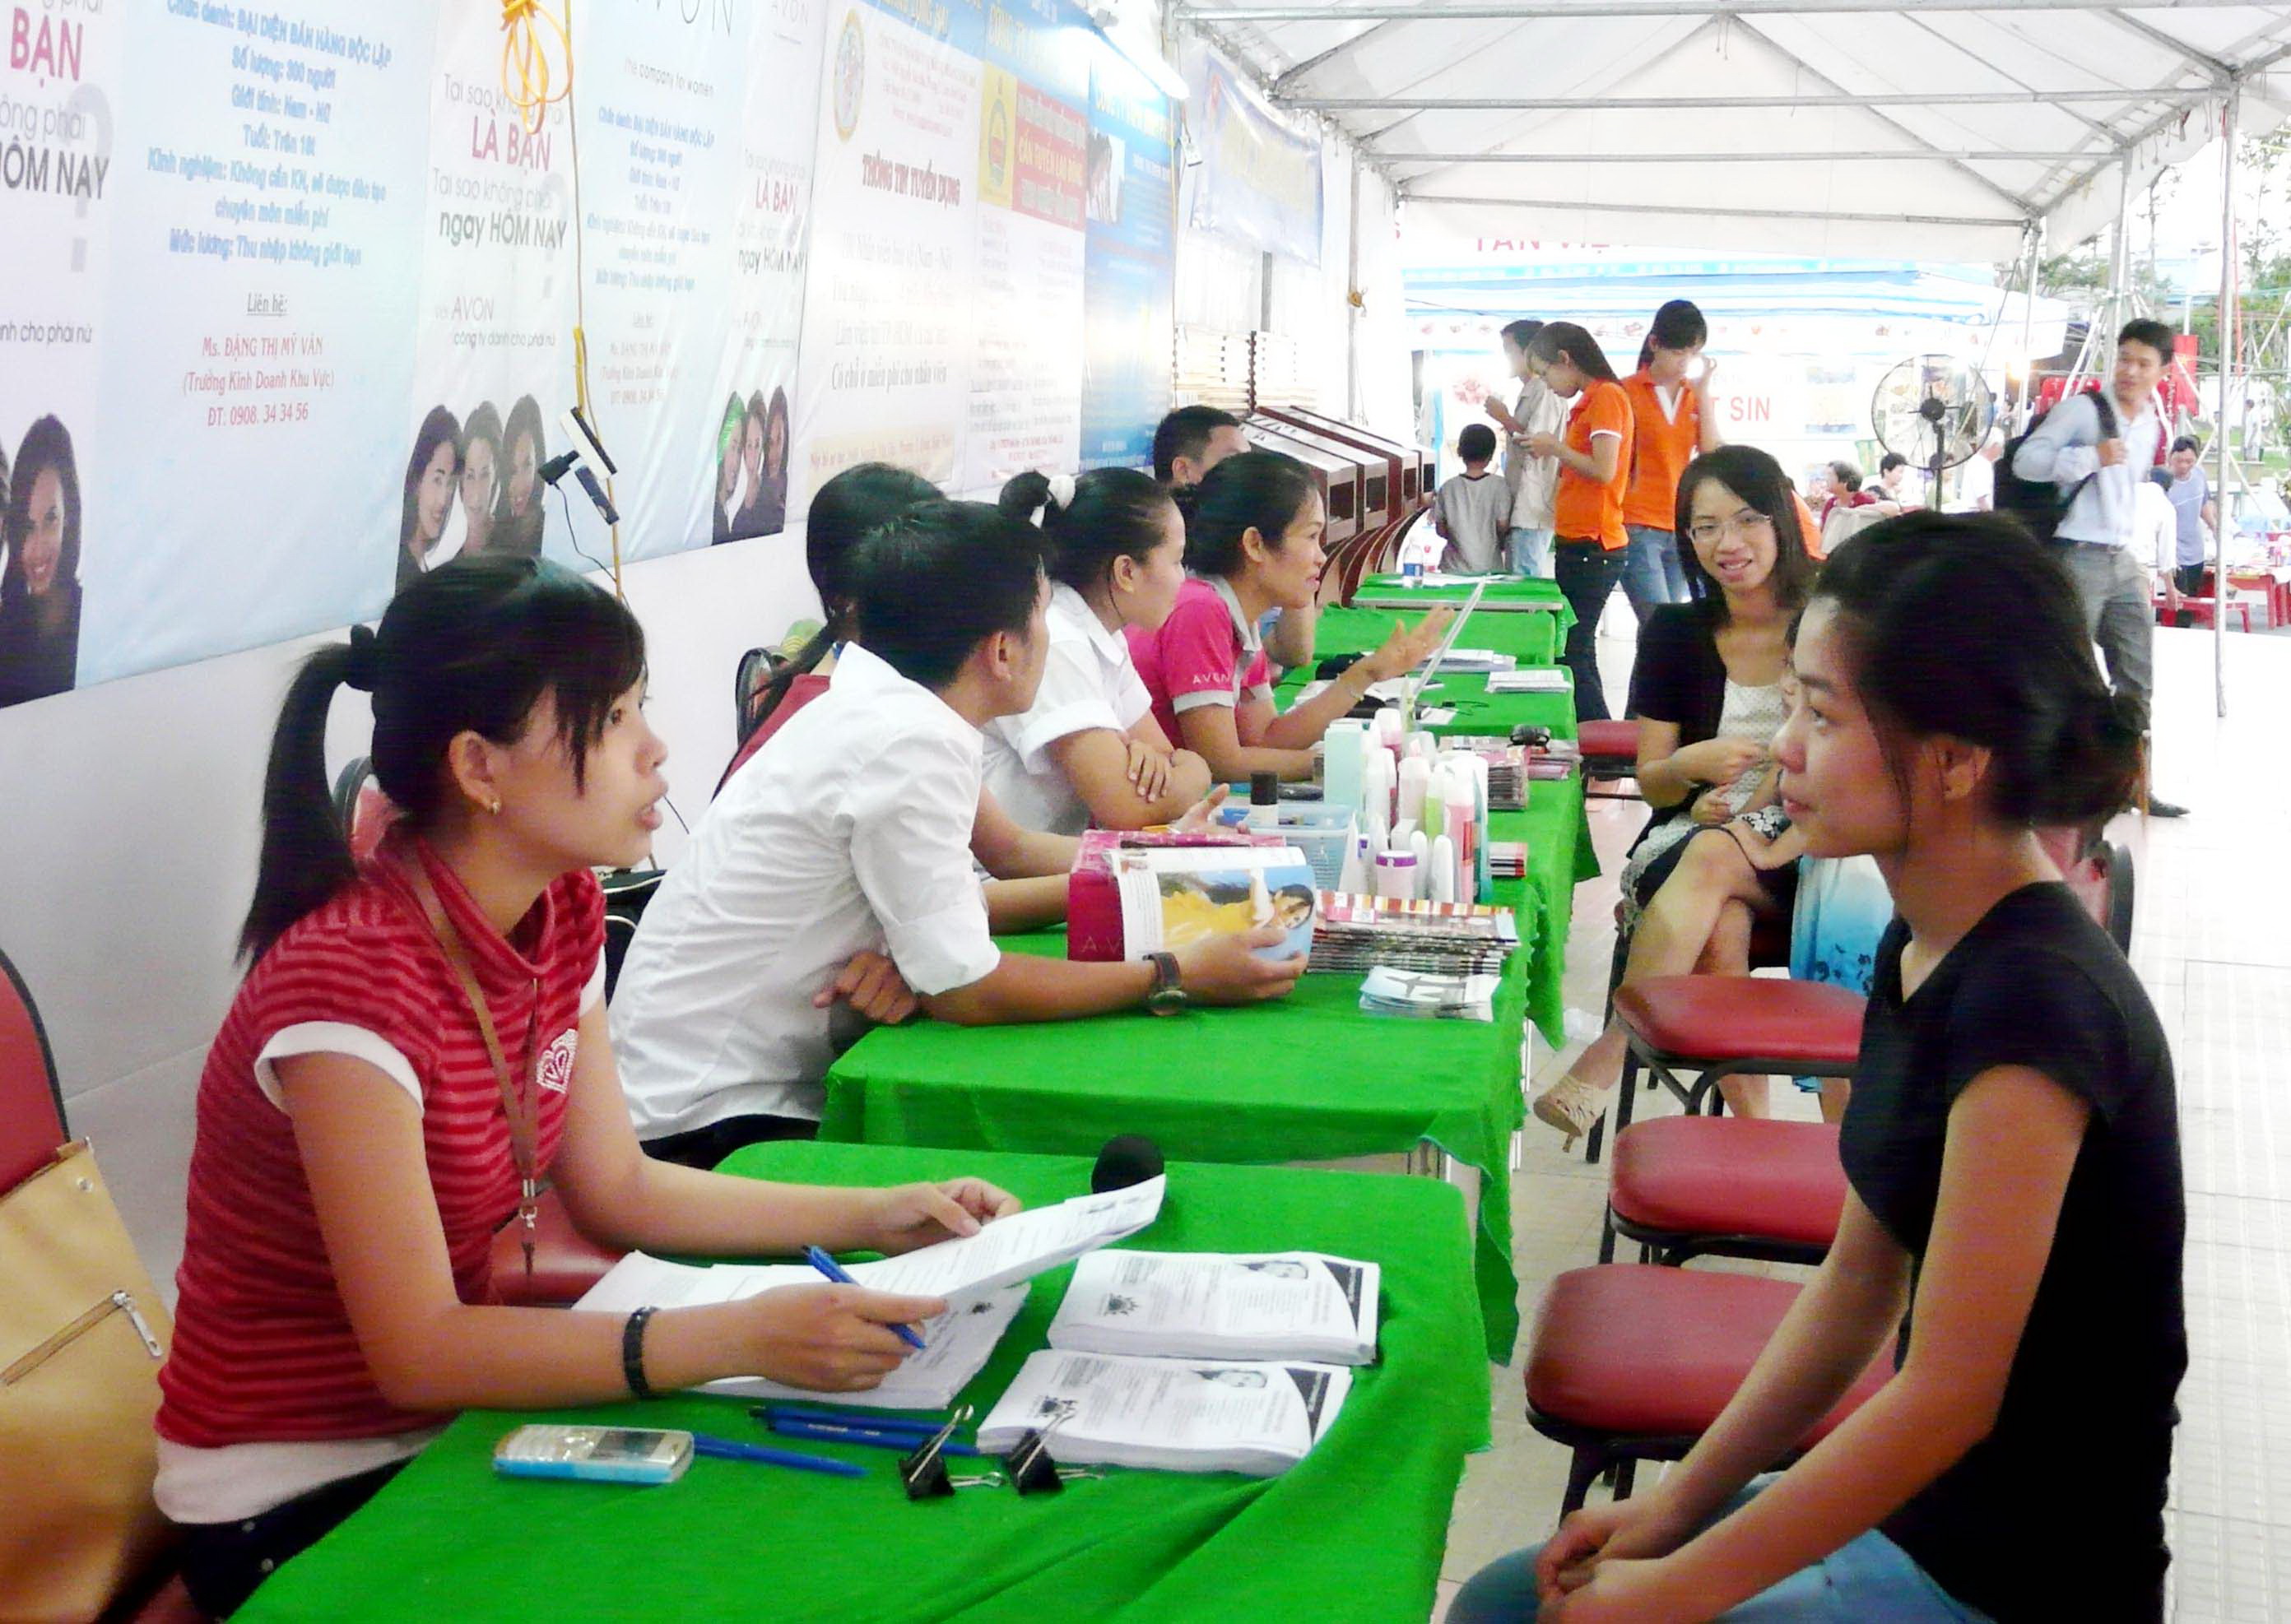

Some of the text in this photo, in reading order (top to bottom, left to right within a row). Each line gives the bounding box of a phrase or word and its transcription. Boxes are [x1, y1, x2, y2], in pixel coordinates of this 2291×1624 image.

[11, 7, 84, 89] BẠN
[472, 107, 552, 176] LÀ BẠN
[0, 134, 110, 201] ÔM NAY
[455, 177, 481, 202] sao
[438, 211, 486, 249] ngay
[489, 206, 531, 247] HÔM
[533, 217, 569, 250] NAY
[452, 296, 495, 322] AVON
[20, 318, 47, 343] cho
[289, 369, 310, 389] Khu
[263, 402, 277, 424] 34
[279, 401, 293, 422] 34
[295, 401, 310, 421] 56
[1730, 396, 1770, 422] SIN
